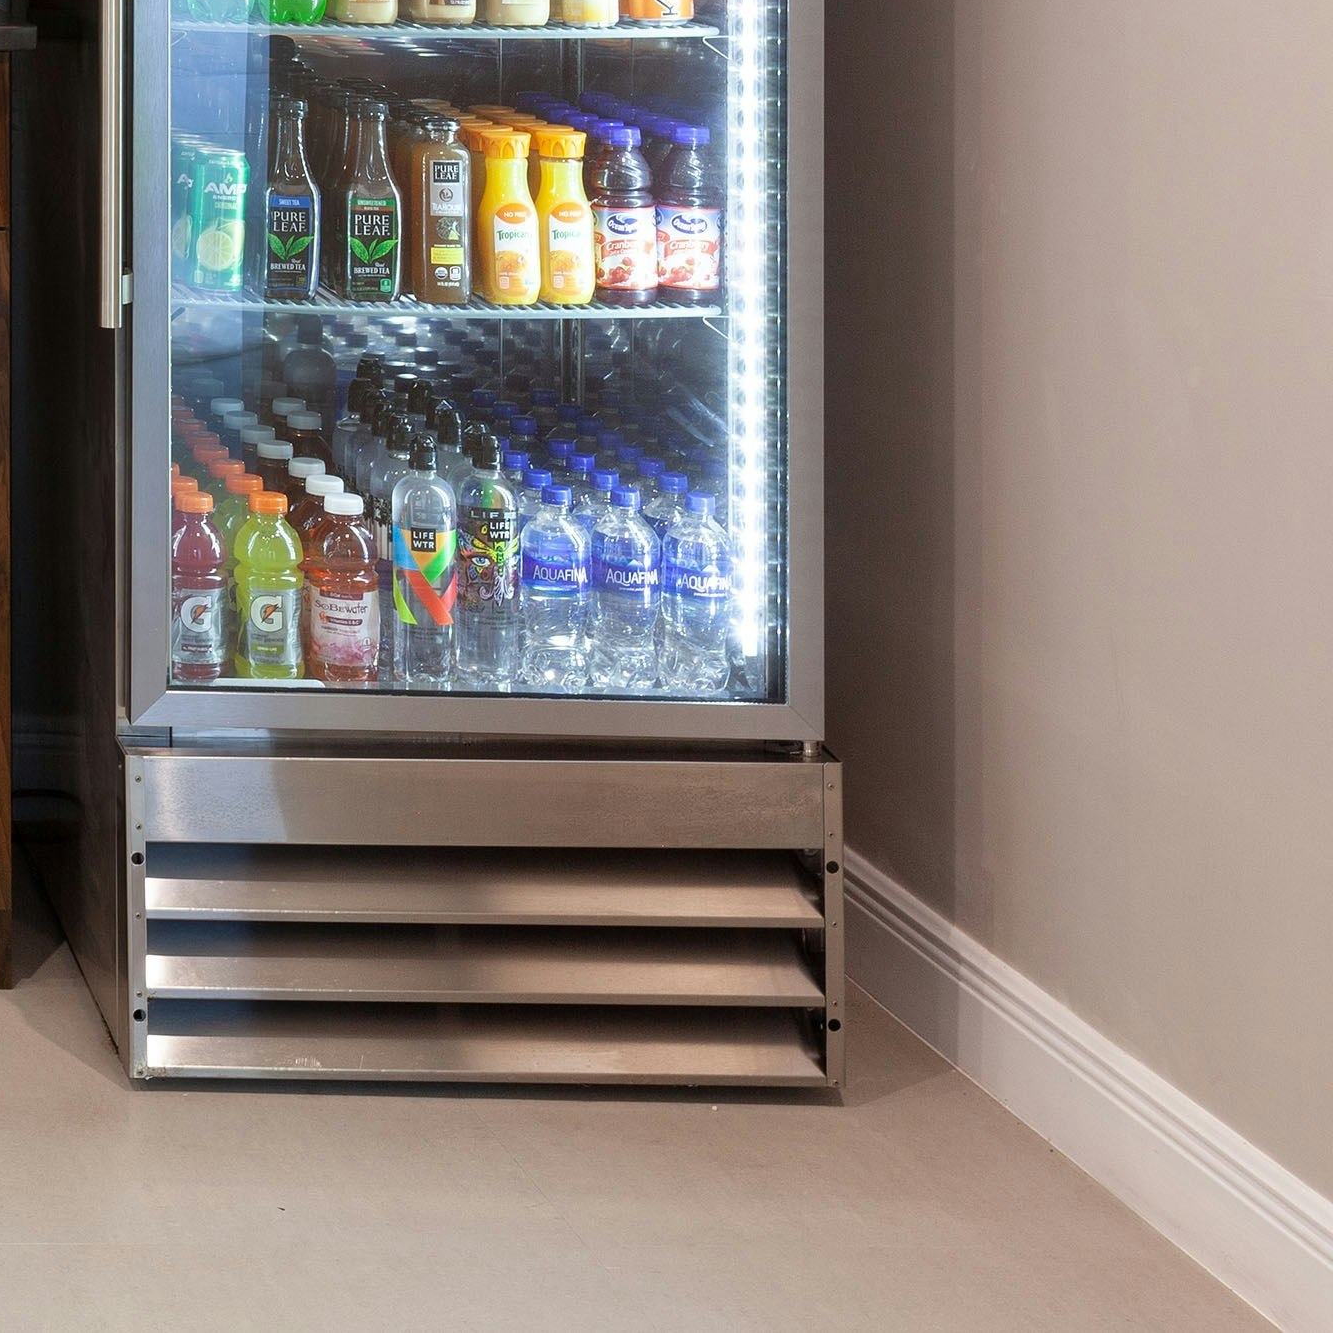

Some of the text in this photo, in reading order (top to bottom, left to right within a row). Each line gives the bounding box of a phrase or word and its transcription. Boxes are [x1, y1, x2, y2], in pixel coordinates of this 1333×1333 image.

[434, 164, 459, 173] PURE
[434, 172, 458, 180] LEAF
[204, 183, 247, 195] AMP
[273, 211, 306, 222] PURE
[354, 214, 390, 226] PURE
[353, 266, 378, 274] BREWED
[490, 521, 510, 530] LIFE
[413, 531, 435, 540] LIFE
[490, 531, 510, 539] WTR
[413, 541, 435, 549] WTR
[533, 564, 588, 584] AQUAFINA
[605, 567, 659, 587] AQUAFINA
[180, 595, 212, 633] G
[250, 595, 283, 633] G
